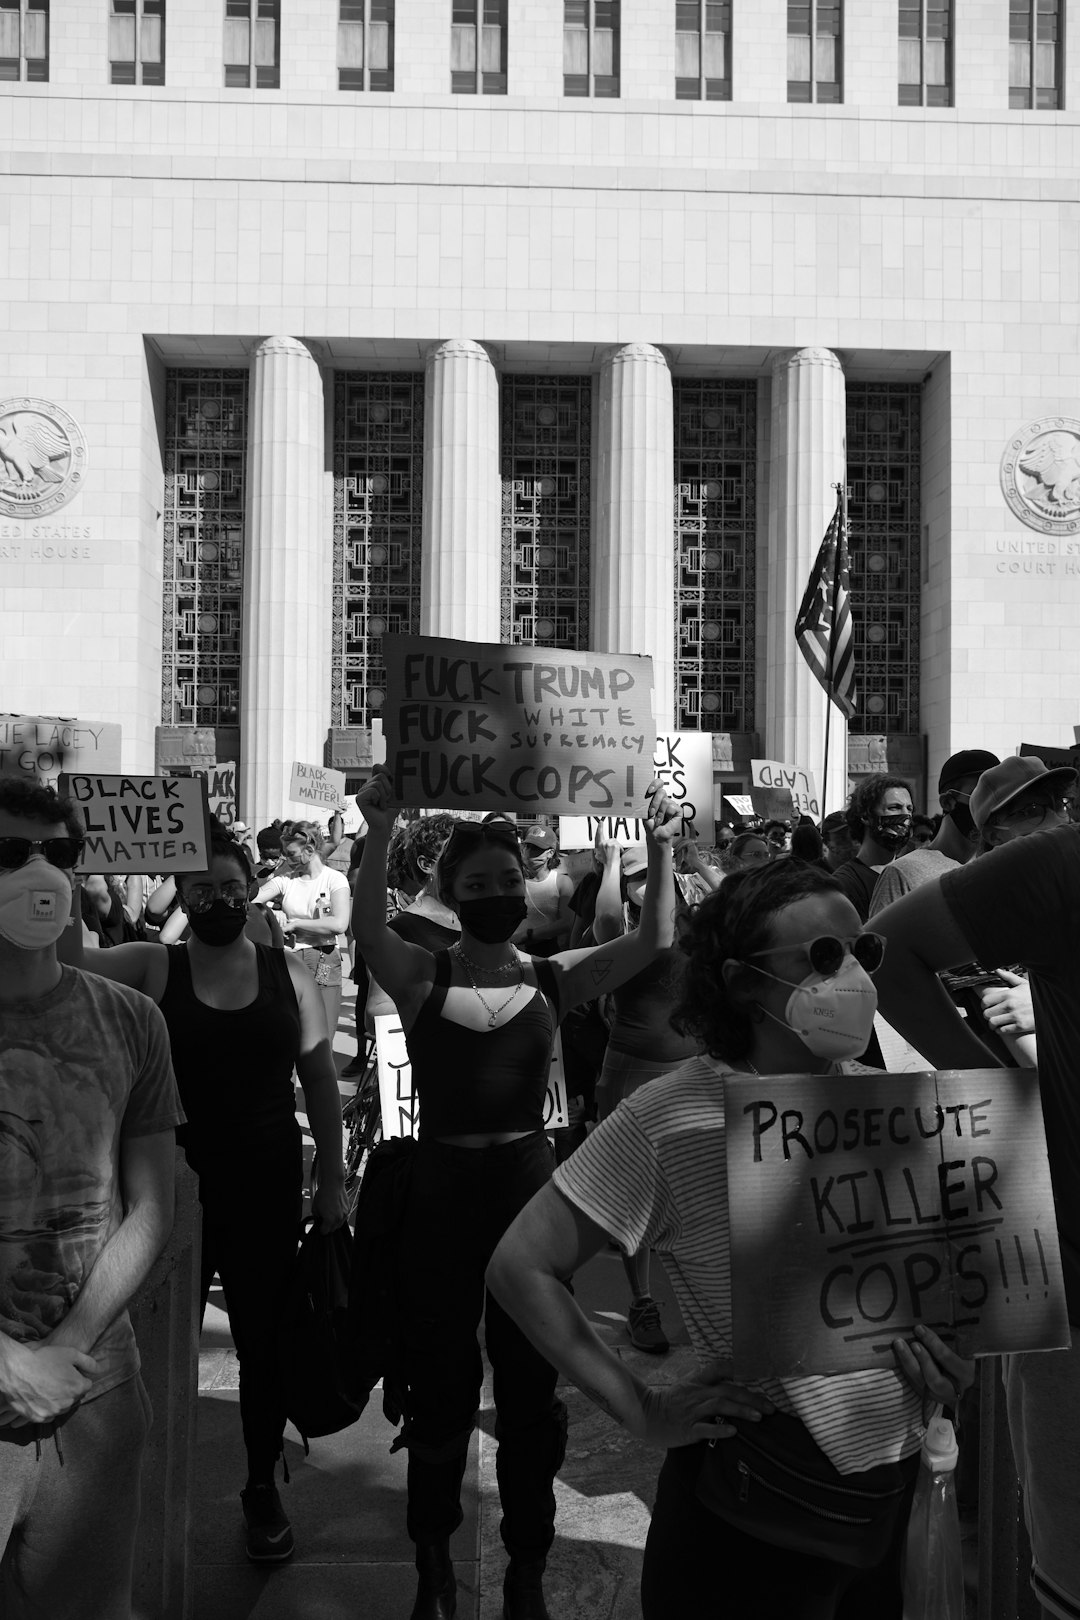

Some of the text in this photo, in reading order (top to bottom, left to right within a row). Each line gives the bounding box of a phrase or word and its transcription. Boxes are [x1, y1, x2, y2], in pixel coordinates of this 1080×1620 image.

[32, 526, 91, 539] STATES
[31, 546, 91, 559] HOUSE
[996, 540, 1056, 554] UNITED
[996, 561, 1080, 575] COURT H
[404, 653, 635, 704] FUCK TRUMP
[400, 703, 636, 744] FUCK WHITE
[0, 723, 104, 751] IE LACEY
[510, 731, 645, 754] SUPREMACY
[18, 750, 64, 774] GO!
[296, 763, 327, 781] BLACK
[71, 776, 180, 801] BLACK
[311, 780, 337, 794] LIVES
[395, 750, 635, 808] FUCK COPS!
[654, 769, 687, 800] ES
[759, 765, 810, 793] LAPD
[299, 786, 340, 804] MATTER!
[83, 803, 185, 834] LIVES
[81, 836, 198, 865] MATTER
[812, 1007, 835, 1019] KN95
[743, 1099, 993, 1162] PROSECUTE
[809, 1156, 1003, 1234] KILLER
[819, 1228, 1049, 1329] COPS!!!
